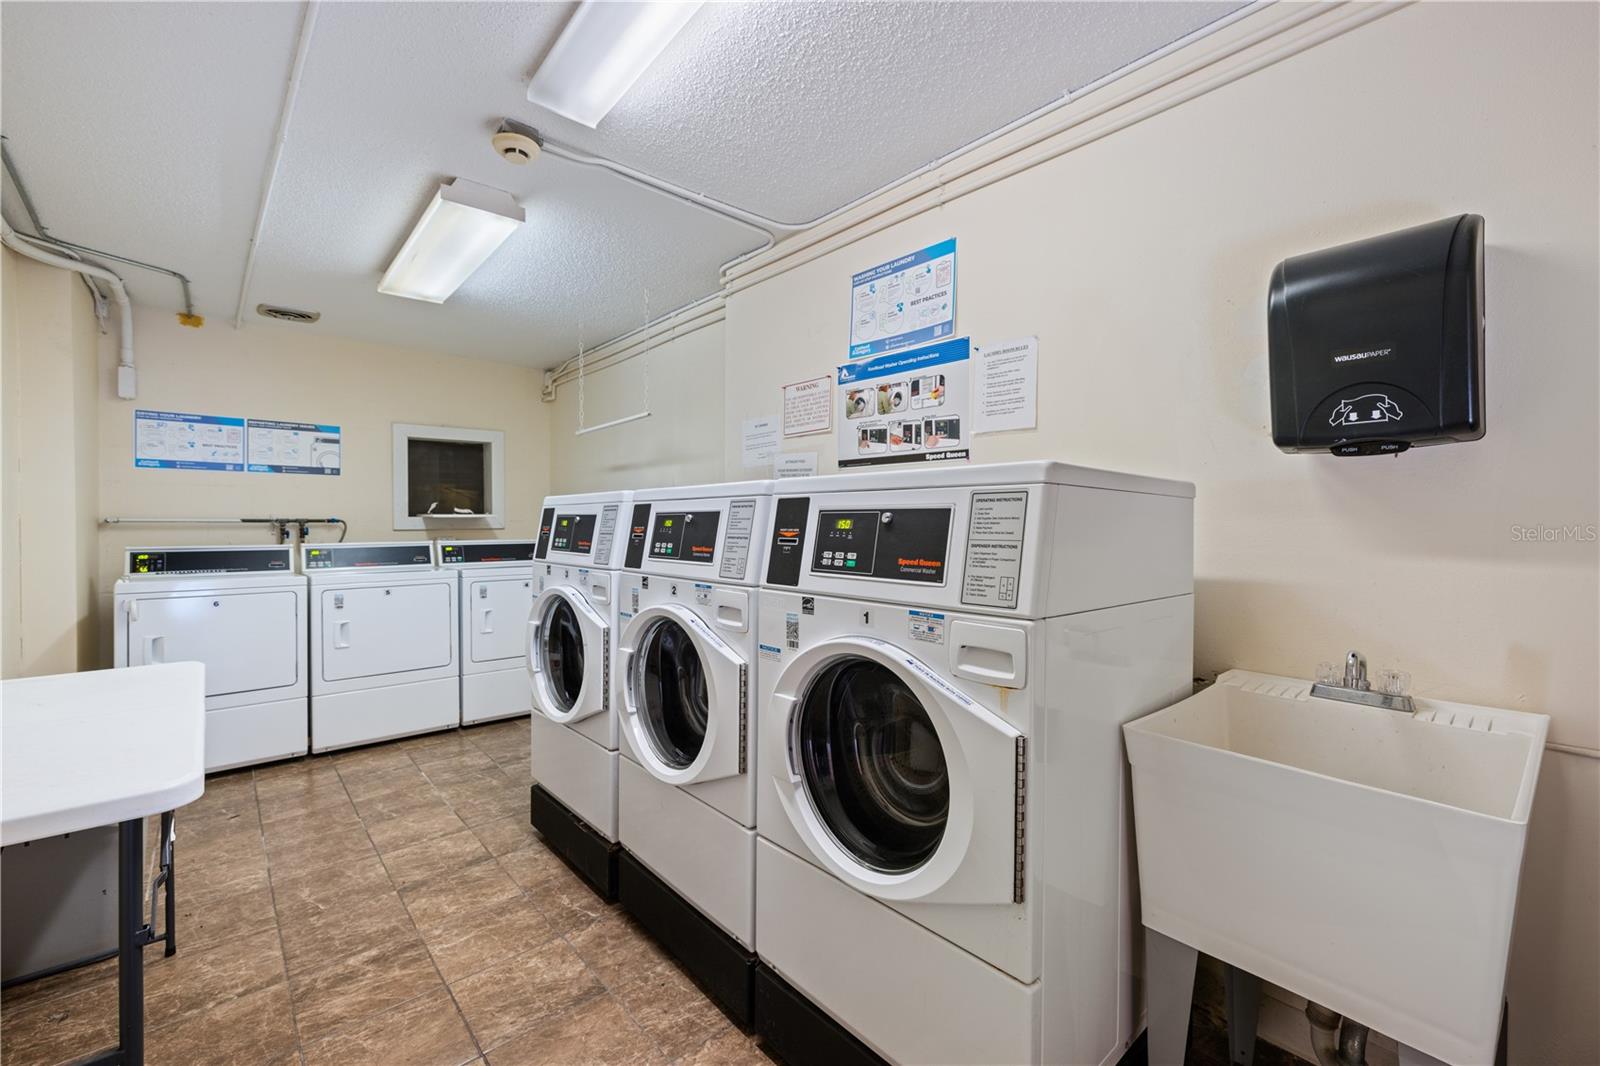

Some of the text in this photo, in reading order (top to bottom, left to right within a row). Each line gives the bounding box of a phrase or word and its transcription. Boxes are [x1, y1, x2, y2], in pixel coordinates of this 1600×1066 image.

[853, 269, 876, 282] WASHING
[877, 265, 890, 274] YOUR
[891, 255, 916, 268] LAUNDRY
[910, 291, 947, 307] BEST PRACTICES
[796, 383, 819, 393] WARNING
[925, 450, 967, 461] Speed Queen
[898, 557, 942, 568] Speed Queen
[900, 566, 937, 575] Commercial Washer
[672, 585, 677, 595] 2
[863, 611, 869, 624] 1
